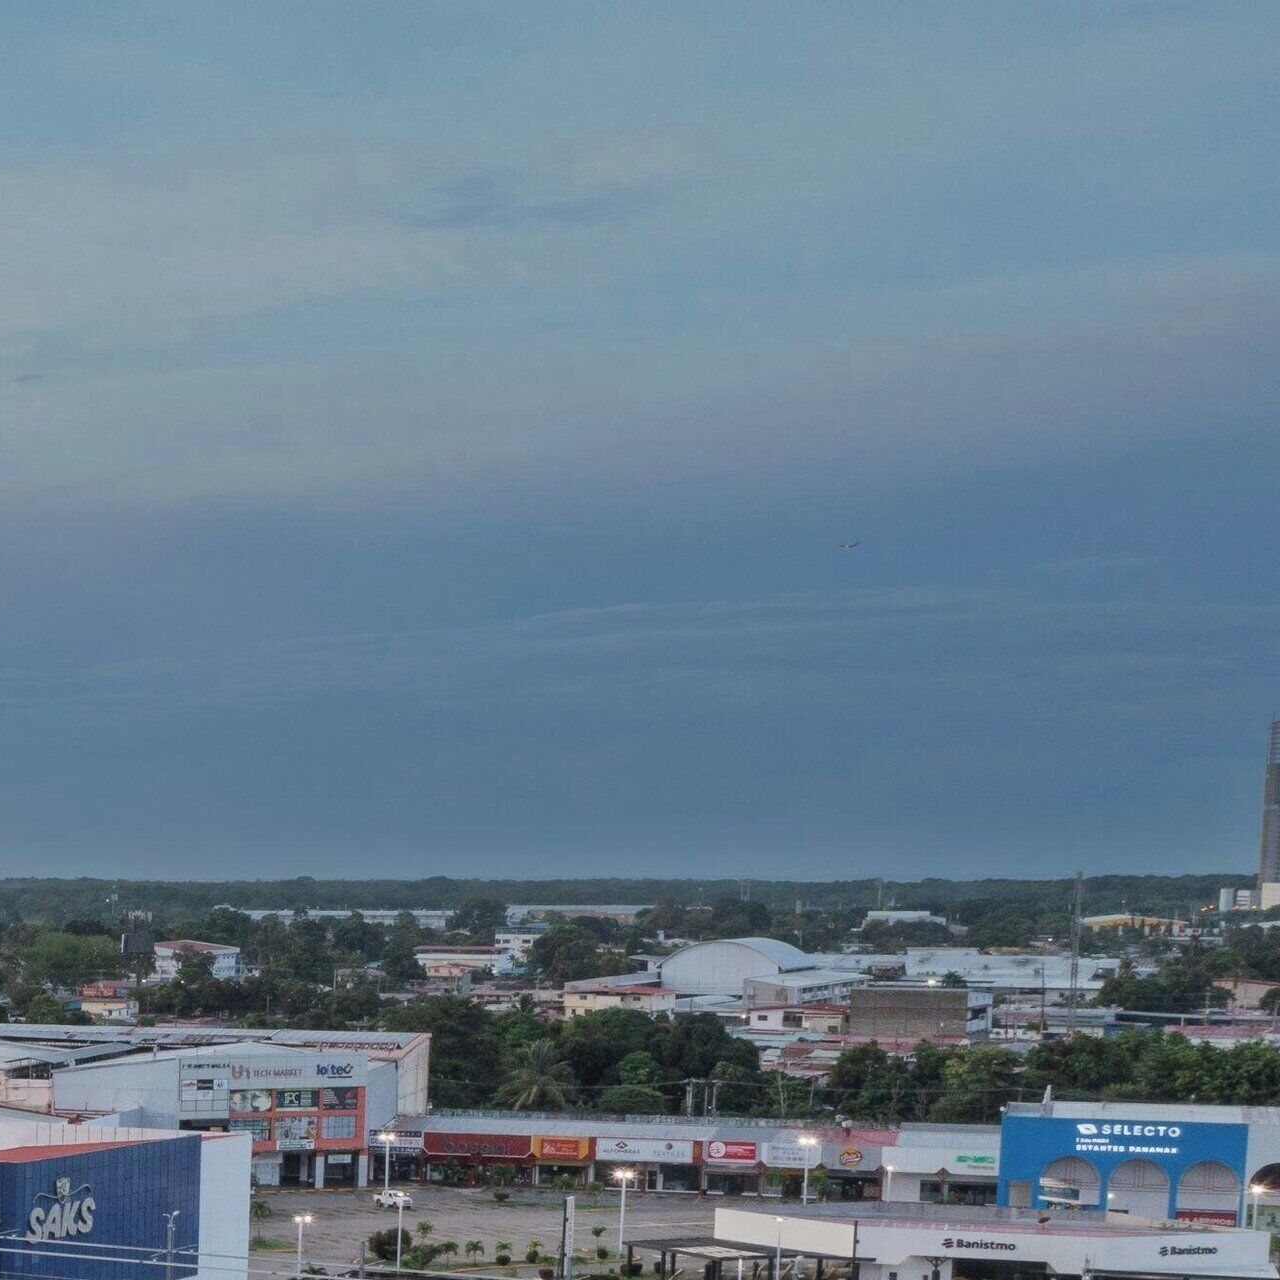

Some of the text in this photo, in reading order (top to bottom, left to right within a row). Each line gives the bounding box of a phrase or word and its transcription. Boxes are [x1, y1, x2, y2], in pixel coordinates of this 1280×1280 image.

[253, 1069, 272, 1077] TECH
[1101, 1124, 1181, 1137] SELECTO
[26, 1197, 96, 1243] SAKS
[956, 1238, 1016, 1251] Banistmo
[1170, 1245, 1218, 1256] Banistmo
